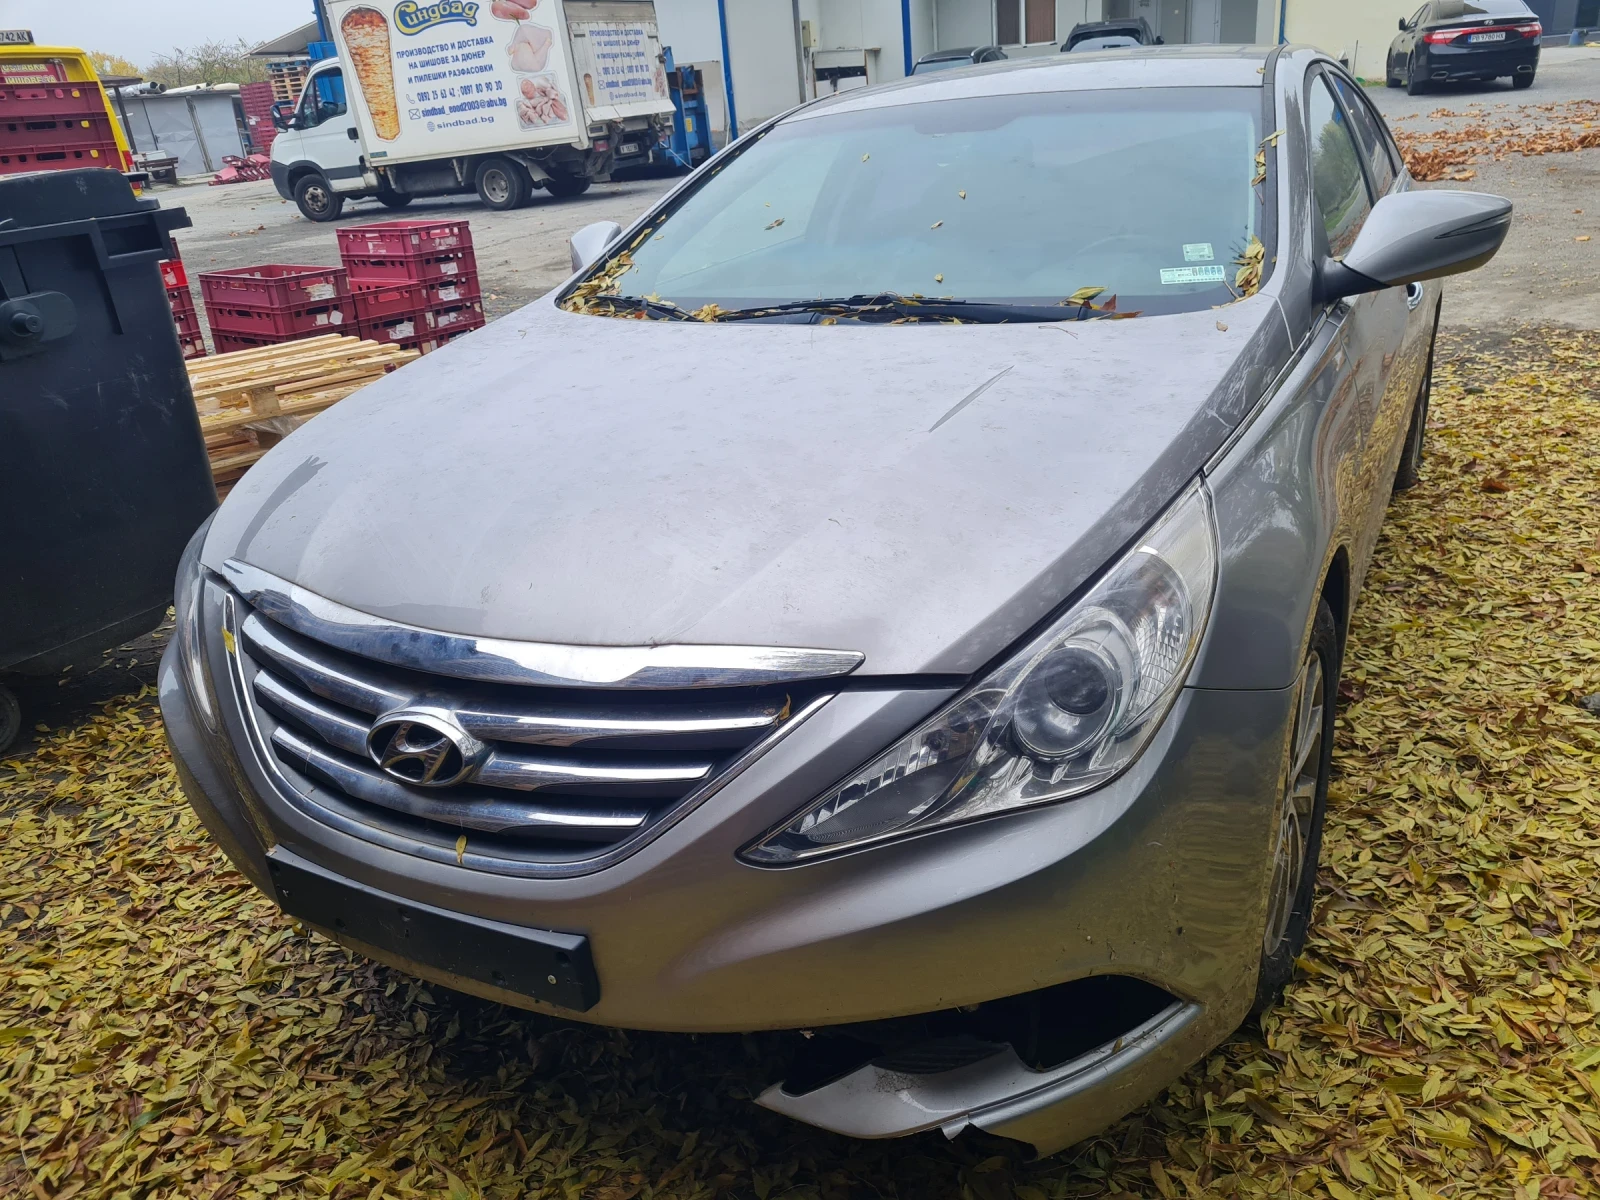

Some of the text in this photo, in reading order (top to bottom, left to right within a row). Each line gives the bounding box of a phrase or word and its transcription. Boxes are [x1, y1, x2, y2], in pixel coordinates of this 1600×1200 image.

[0, 32, 15, 41] 742
[396, 36, 494, 59] ПРОИЗВОДСТВО И ДОСТАВКА
[408, 50, 486, 70] НА ШИШОВЕ ЗА ДЮНЕР
[414, 71, 447, 83] ПИЛЕШКИ
[448, 64, 494, 79] РАЗФАСОВКИ
[416, 91, 430, 102] 0892
[449, 87, 456, 97] 42
[475, 83, 483, 94] 80
[485, 81, 493, 92] 90
[494, 80, 502, 91] 30
[421, 97, 507, 118] sindbad_eood2003@abv.bg
[437, 116, 494, 130] sindbad.bg
